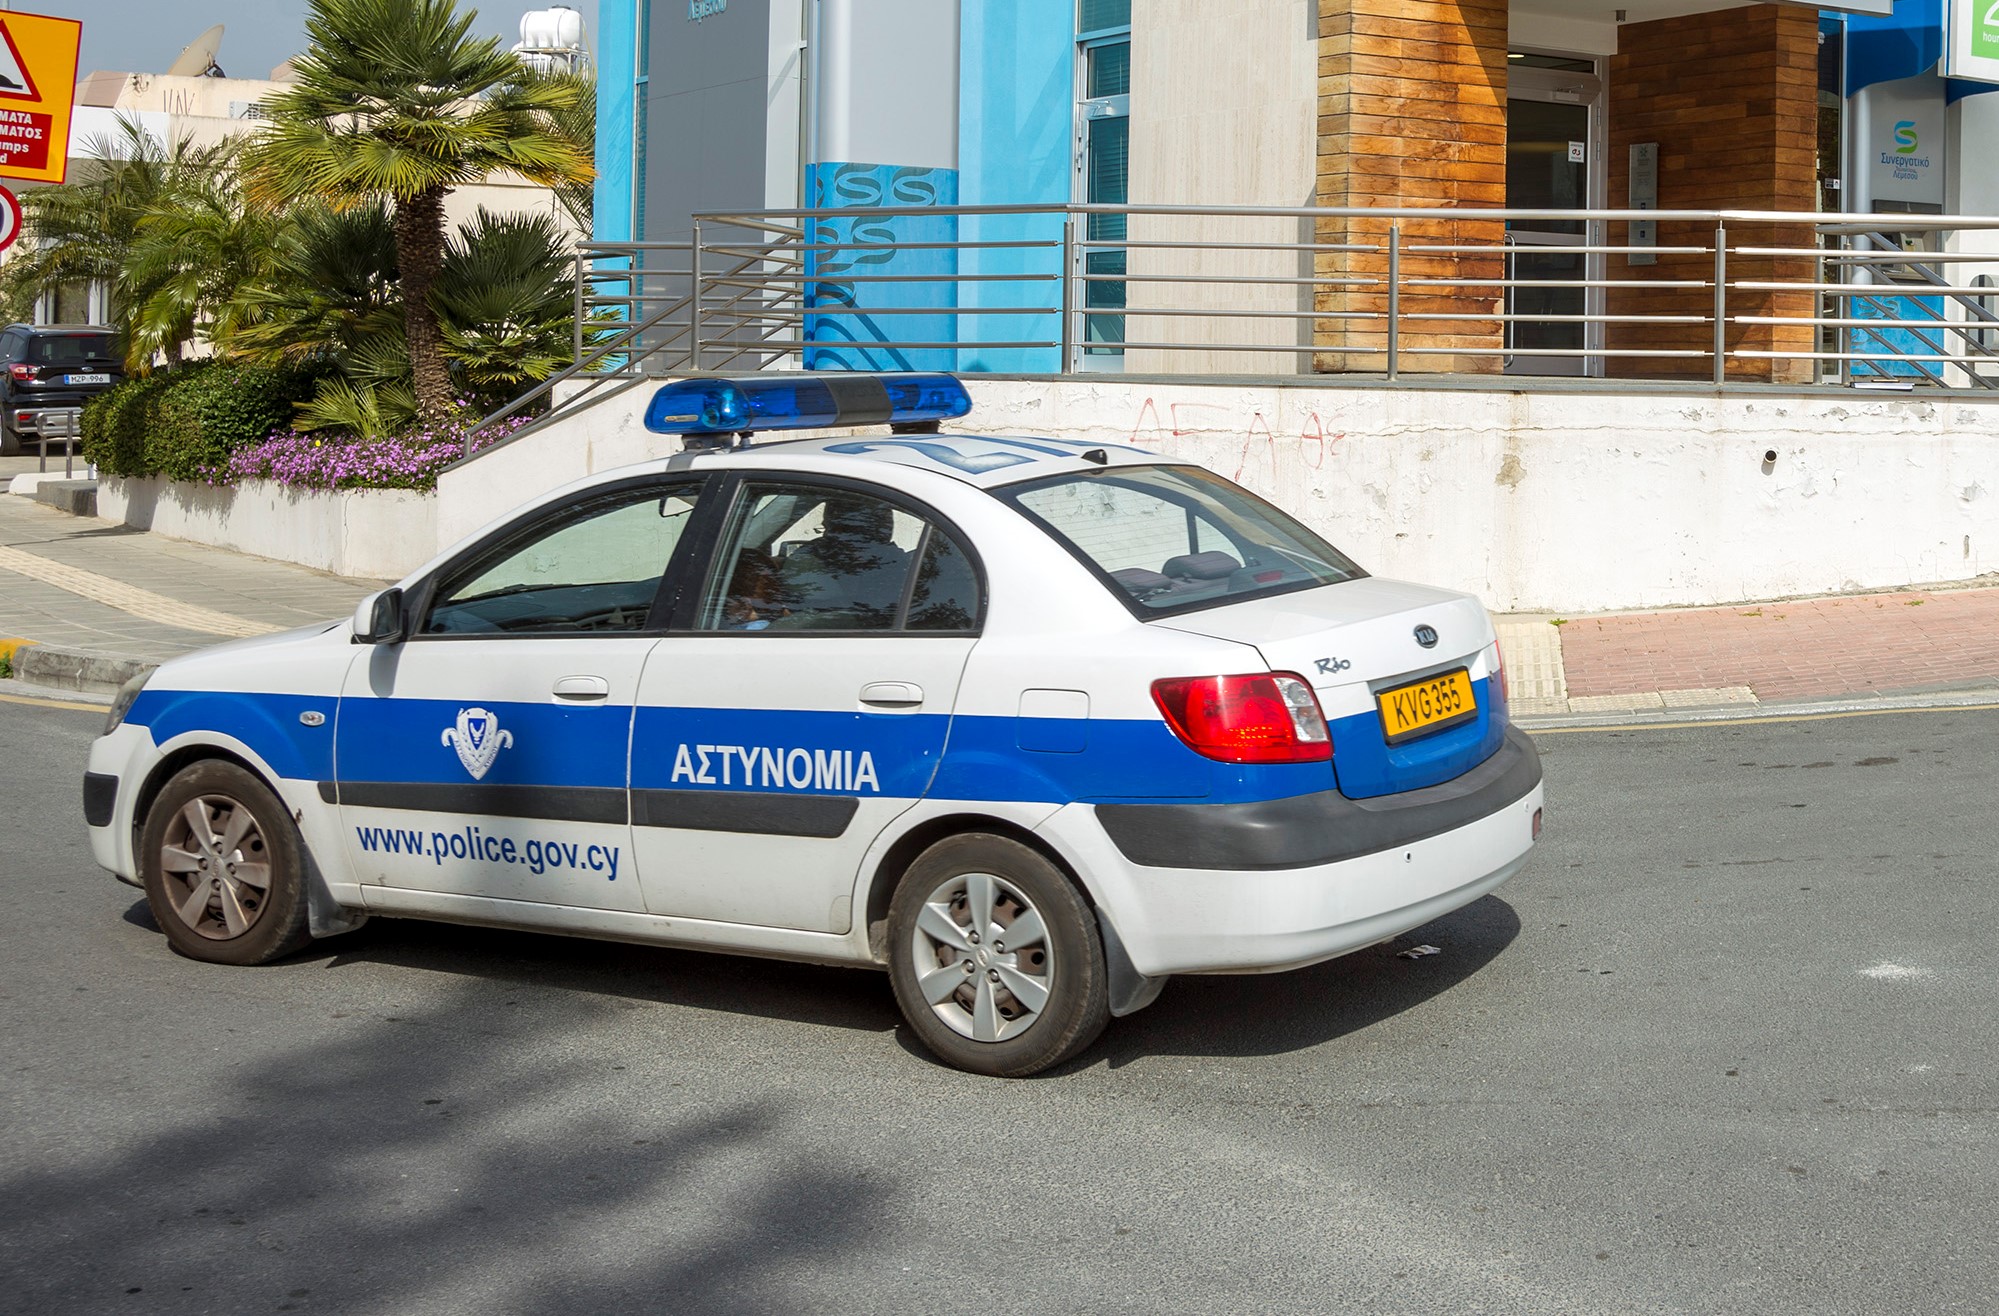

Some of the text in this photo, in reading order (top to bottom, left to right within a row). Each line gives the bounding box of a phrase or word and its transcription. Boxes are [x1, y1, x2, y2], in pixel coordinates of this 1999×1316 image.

[0, 141, 29, 154] mps
[1314, 657, 1350, 674] Rio
[671, 744, 880, 792] ΑΣΤΥΝΟΜΙΑ
[356, 826, 619, 881] www.police.gov.cy
